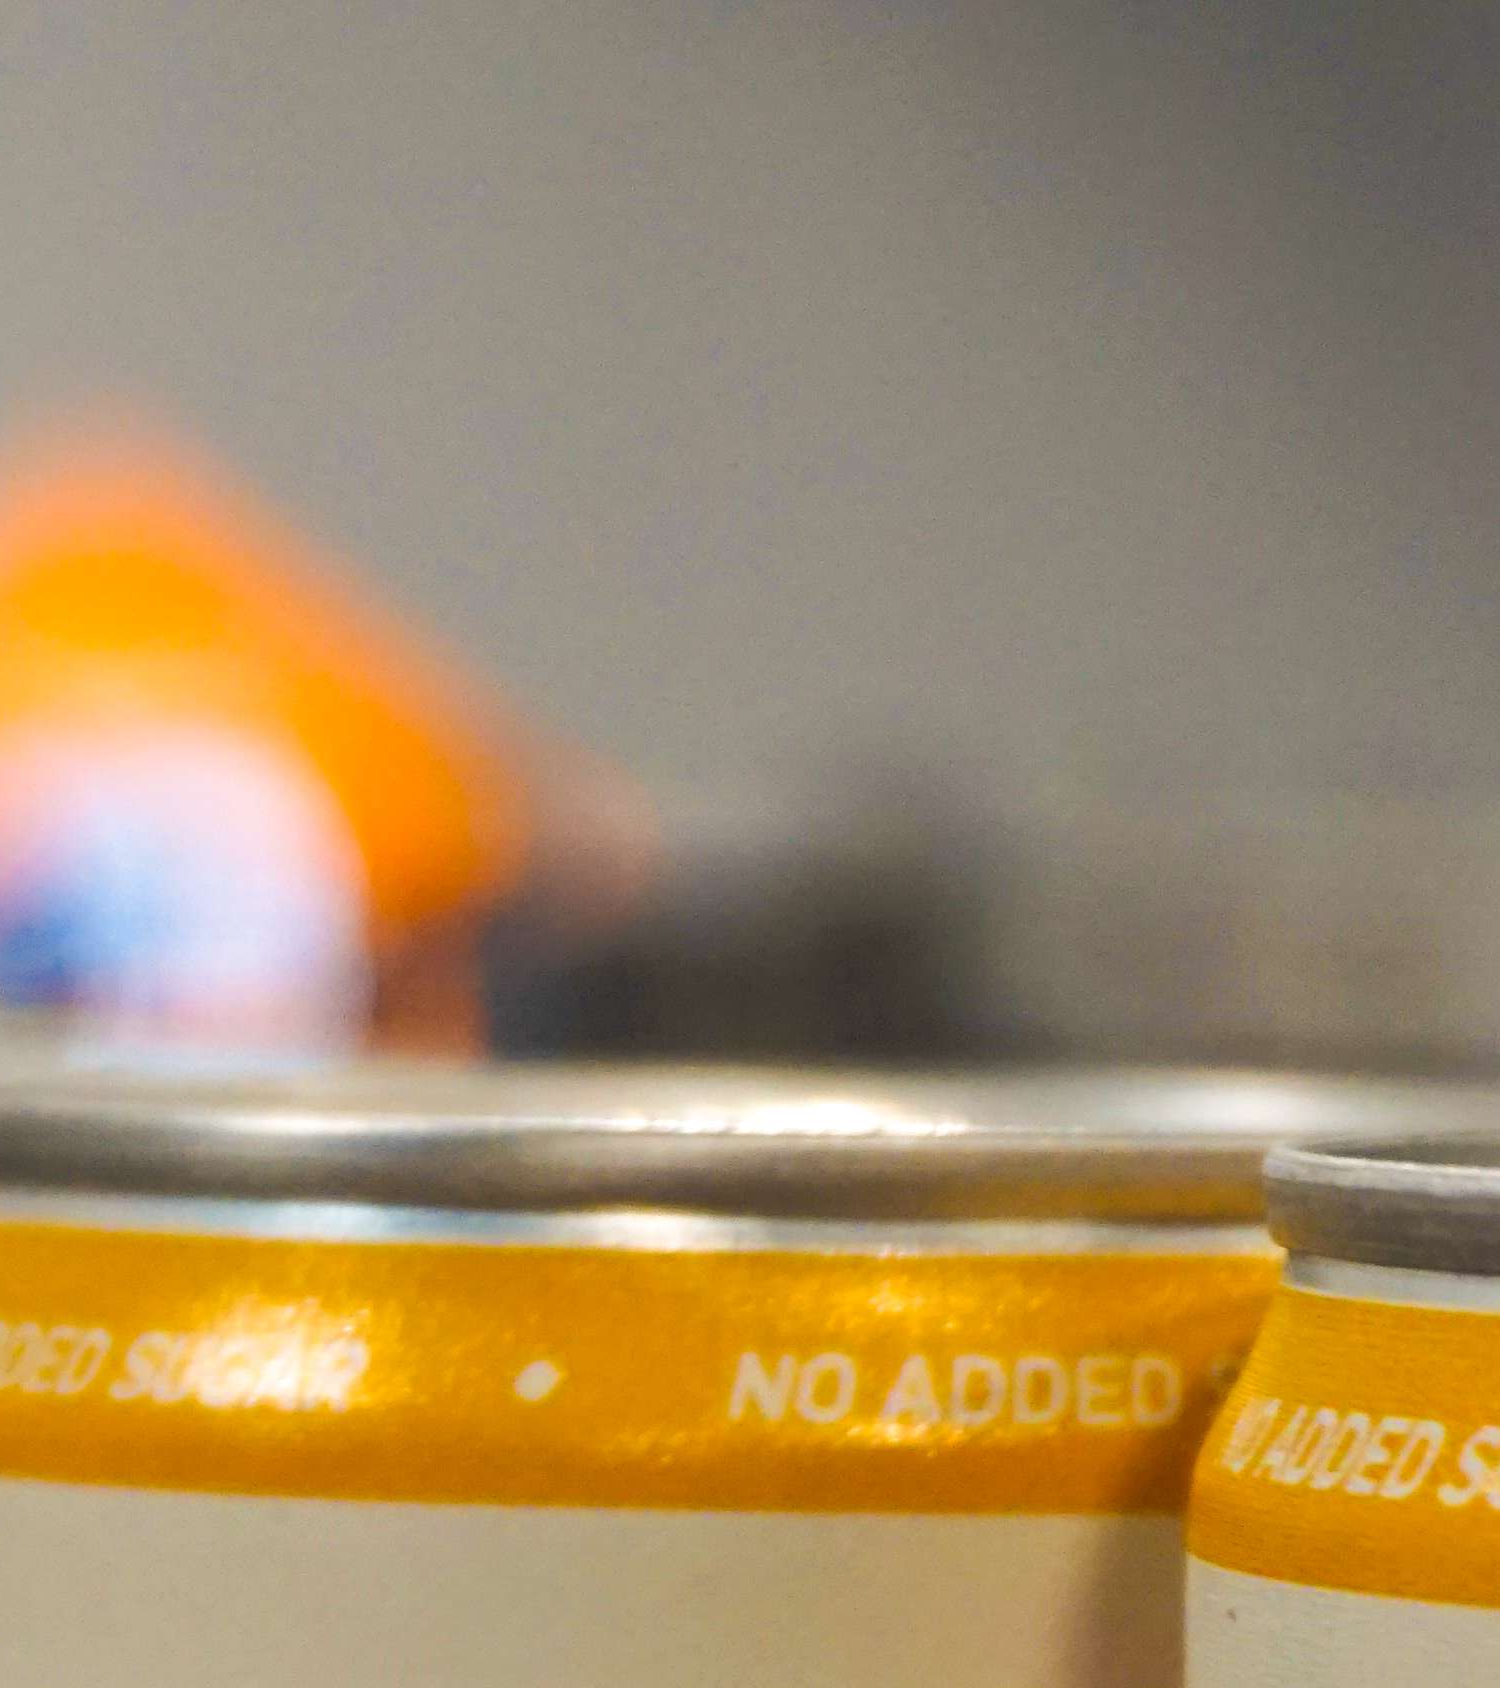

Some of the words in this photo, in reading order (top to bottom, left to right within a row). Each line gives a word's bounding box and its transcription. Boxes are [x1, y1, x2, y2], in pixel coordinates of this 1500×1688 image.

[108, 1329, 370, 1412] SUGAR
[728, 1351, 856, 1423] NO
[880, 1353, 1182, 1426] ADDED
[1257, 1404, 1446, 1500] ADDED
